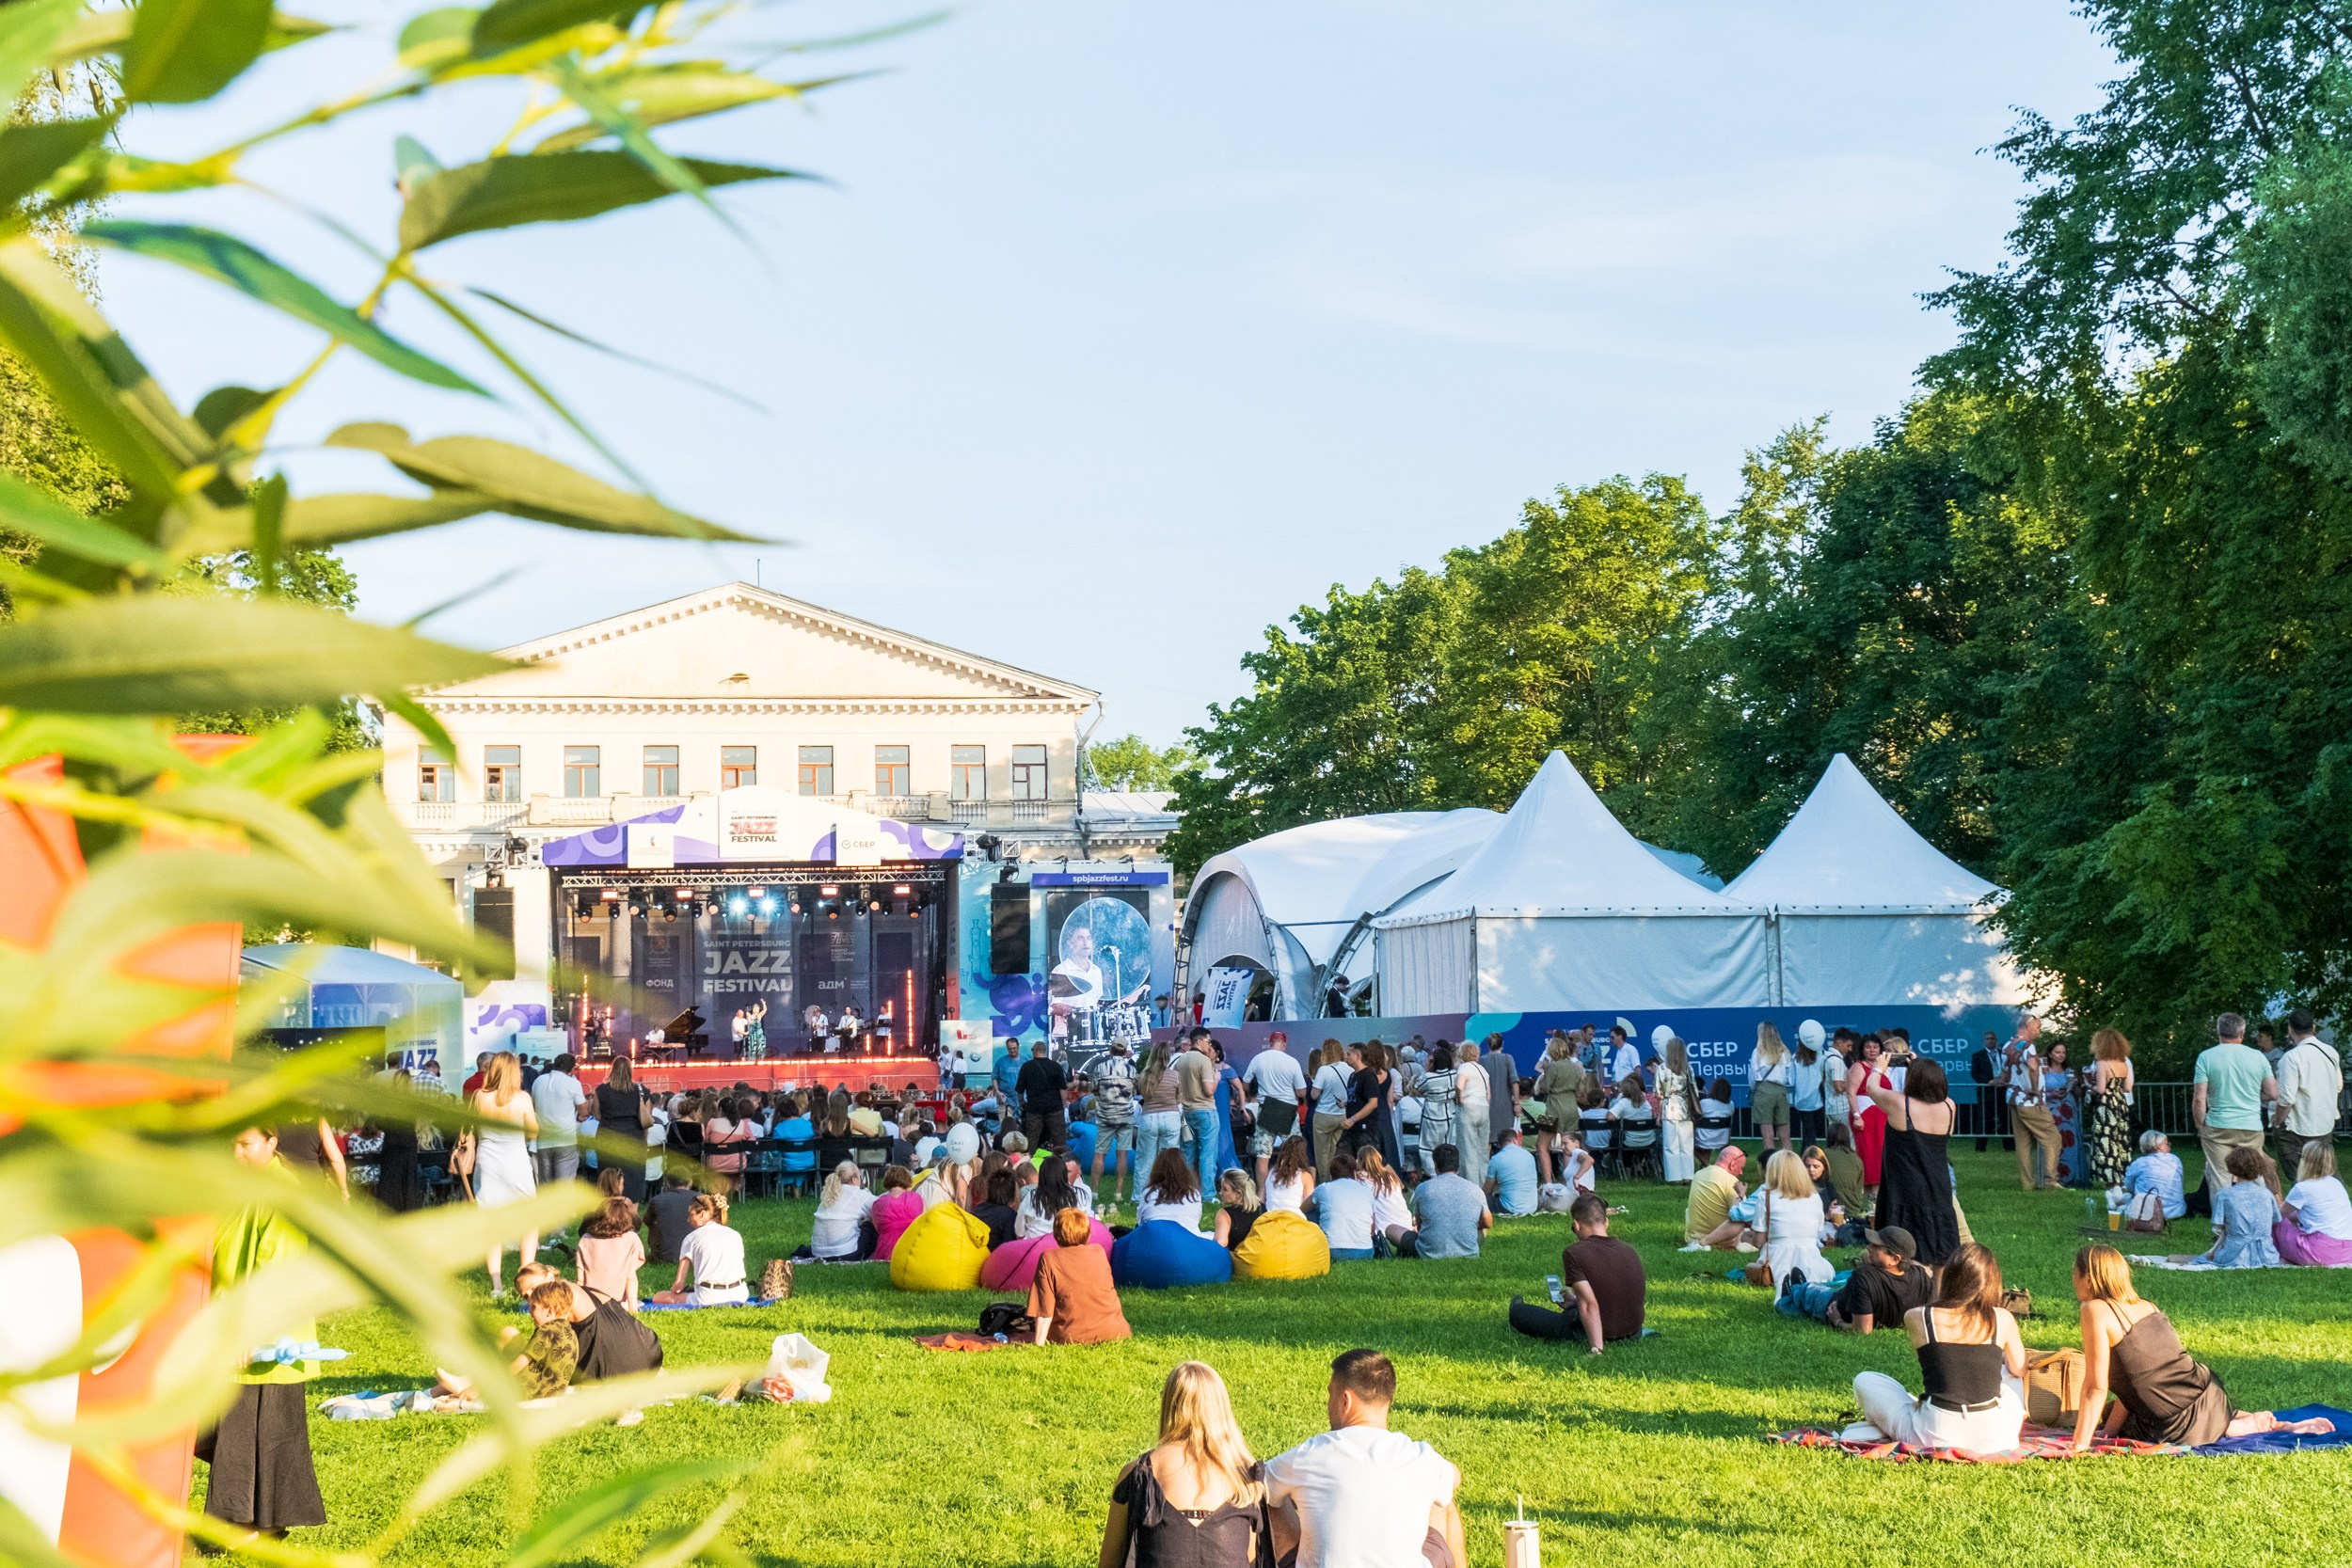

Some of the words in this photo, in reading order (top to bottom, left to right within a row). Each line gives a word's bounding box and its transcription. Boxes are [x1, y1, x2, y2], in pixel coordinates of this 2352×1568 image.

[729, 821, 778, 834] JAZZ
[1073, 874, 1129, 883] spbjazzfest.ru
[704, 950, 791, 974] JAZZ
[645, 979, 675, 988] ФОНД
[703, 978, 793, 993] FESTIVAL
[1686, 1041, 1739, 1057] СБЕР
[1917, 1038, 1969, 1053] СБЕР
